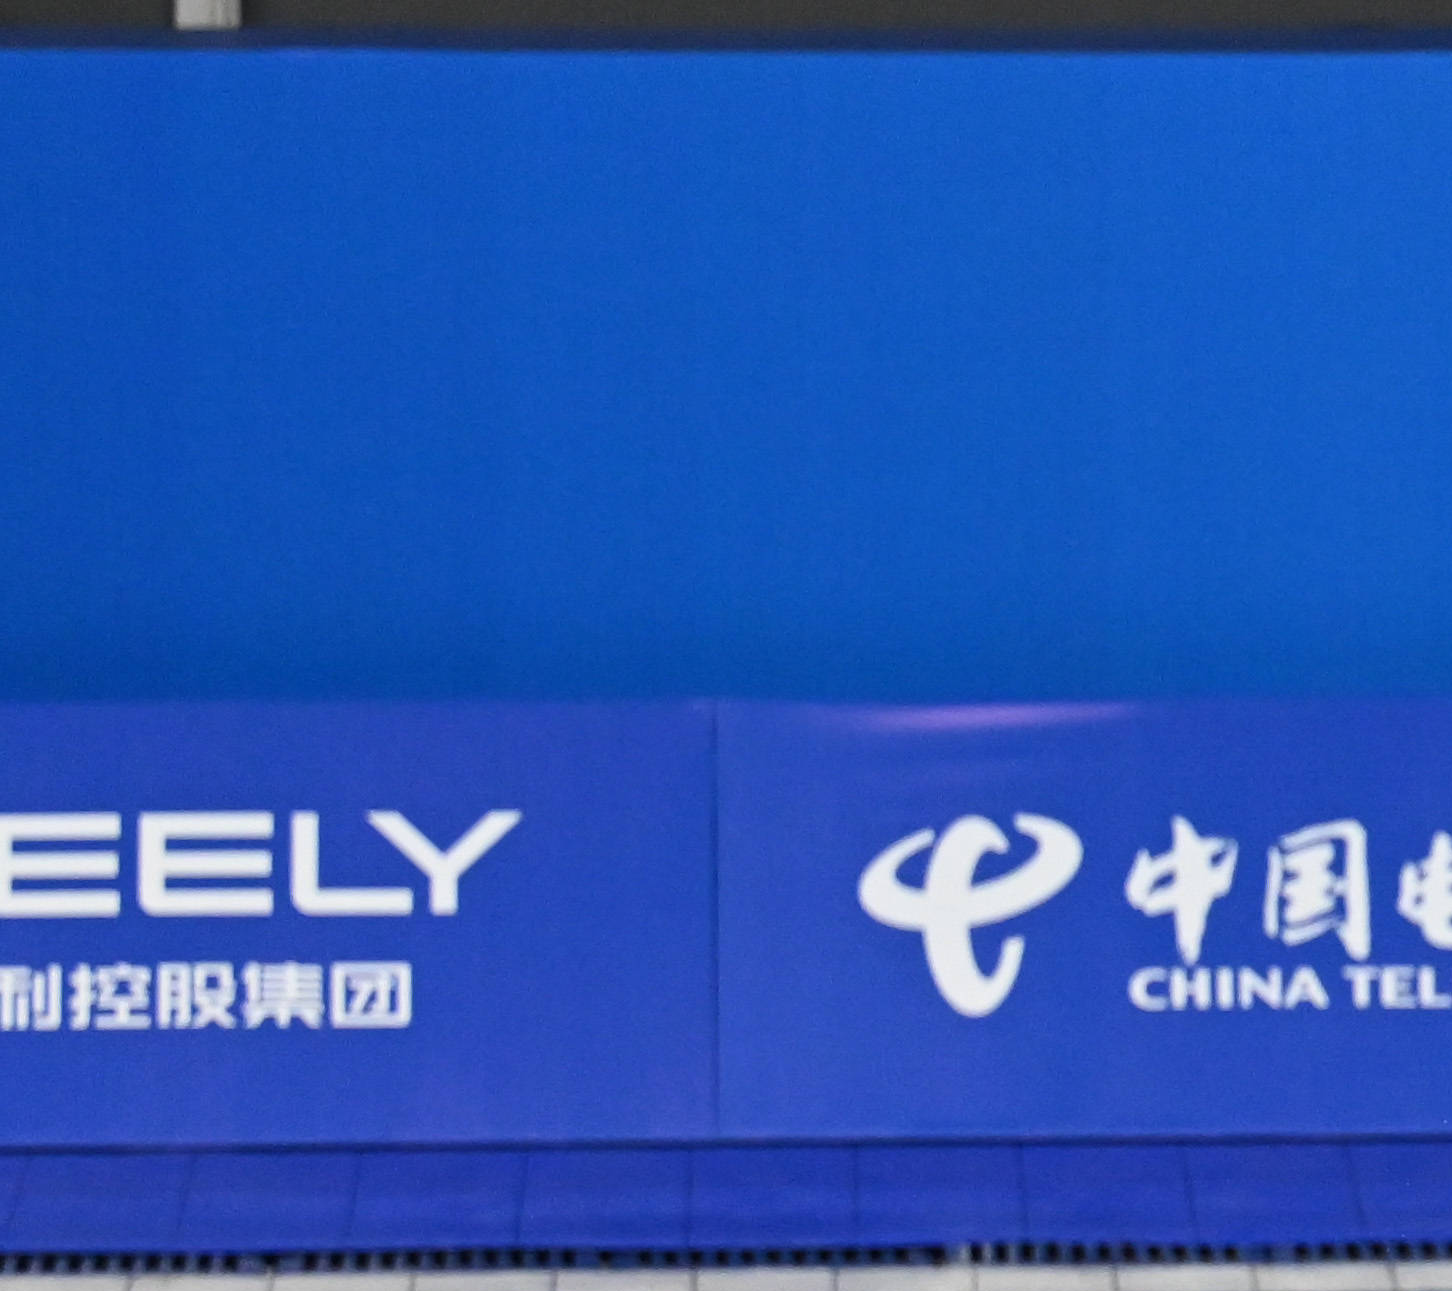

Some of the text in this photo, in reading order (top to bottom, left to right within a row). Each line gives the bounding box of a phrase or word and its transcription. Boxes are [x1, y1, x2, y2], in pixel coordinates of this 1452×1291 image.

[0, 810, 523, 919] EELY
[0, 961, 412, 1032] 利控股集团
[1128, 964, 1329, 1013] CHINA
